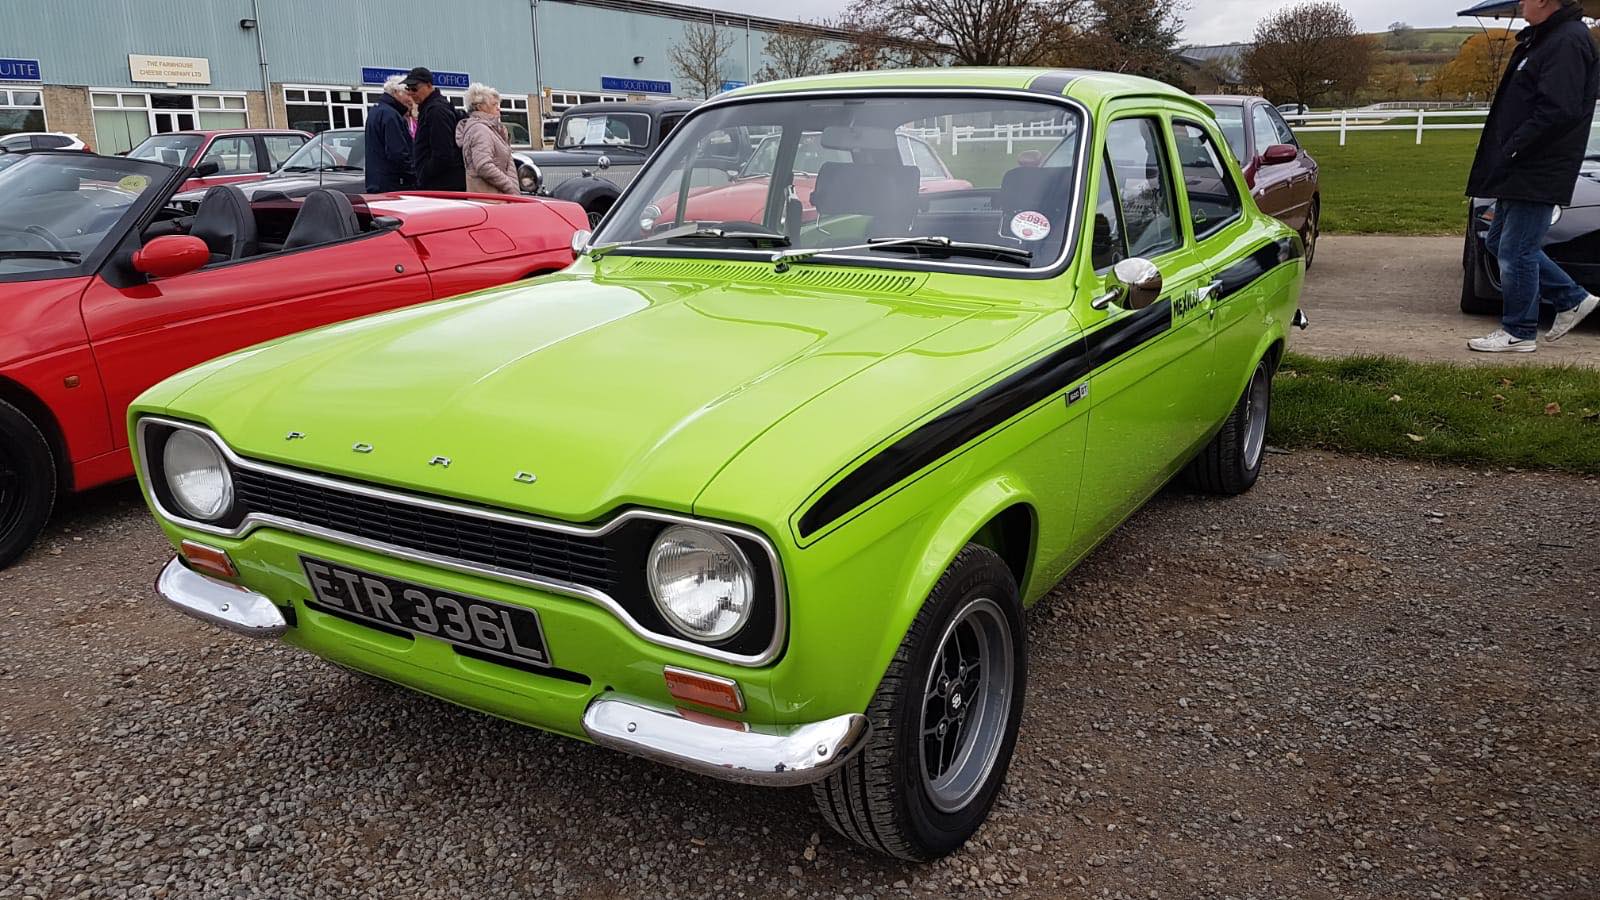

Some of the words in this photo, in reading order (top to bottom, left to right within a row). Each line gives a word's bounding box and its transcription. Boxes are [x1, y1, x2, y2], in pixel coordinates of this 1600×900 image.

[438, 75, 468, 87] OFFICE
[623, 79, 649, 91] SOCIETY
[649, 82, 670, 93] OFFICE
[286, 431, 537, 485] FORD
[305, 561, 402, 624] ETR
[403, 589, 542, 660] 336L
